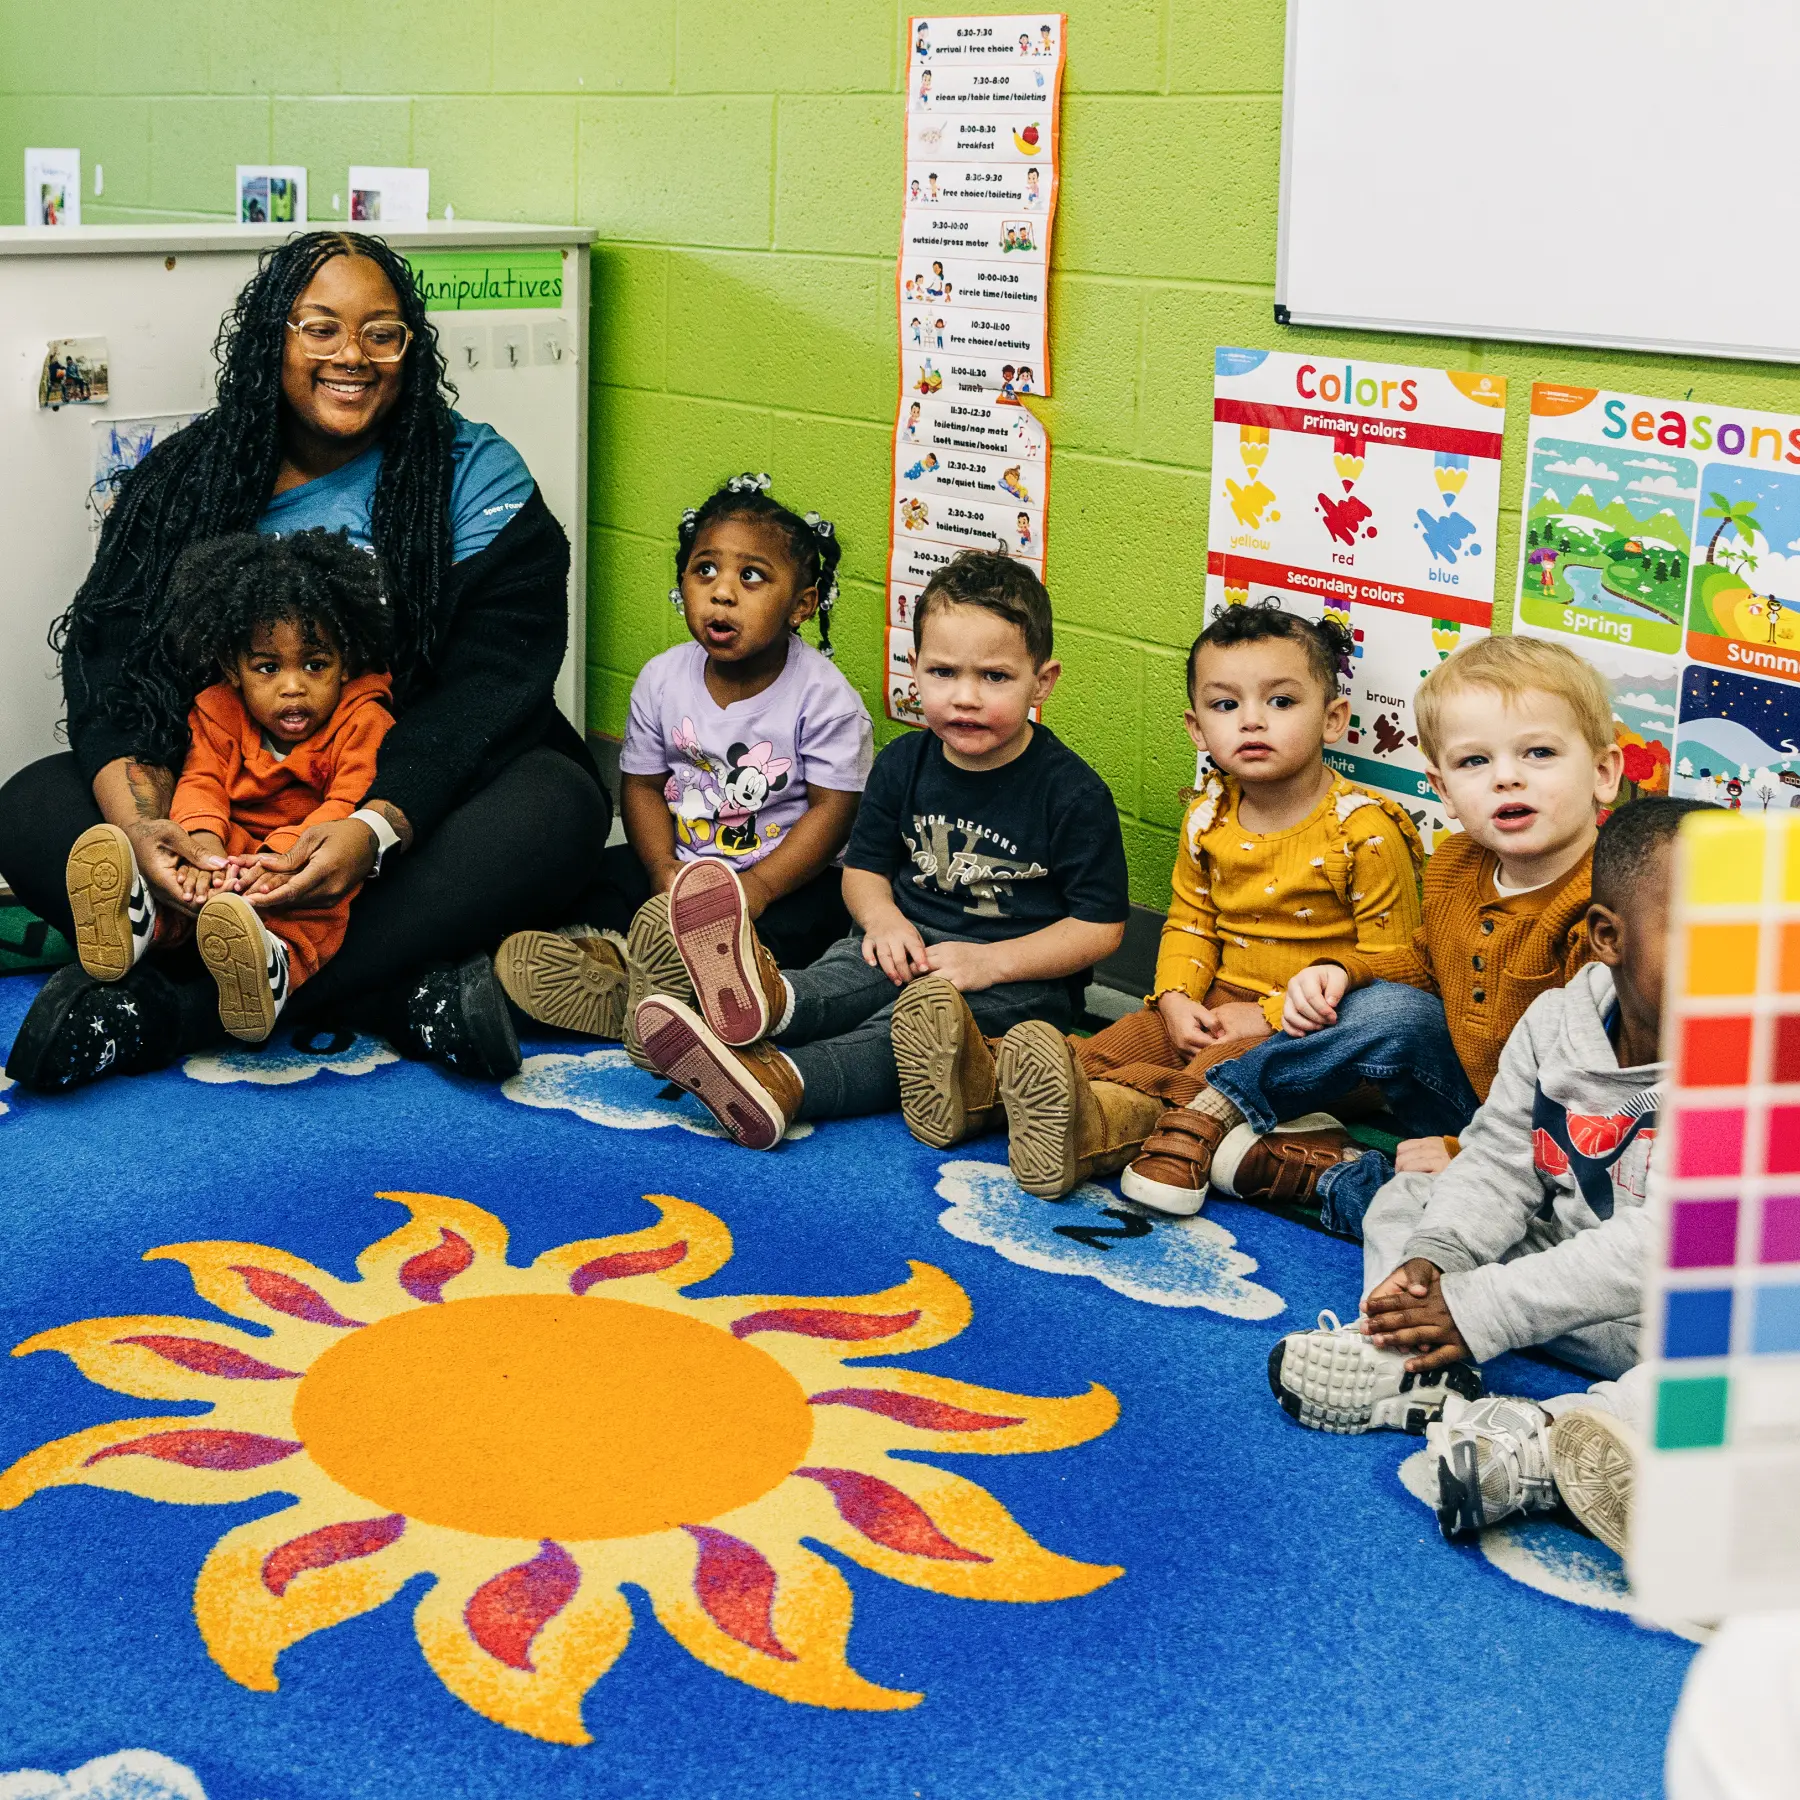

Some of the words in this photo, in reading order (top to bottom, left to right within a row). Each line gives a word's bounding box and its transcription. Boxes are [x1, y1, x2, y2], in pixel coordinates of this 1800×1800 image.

[957, 28, 993, 37] 6:30-7:30
[935, 46, 962, 54] arrival
[969, 45, 985, 53] free
[987, 44, 1014, 53] choice
[973, 76, 1010, 85] 7:30-8:00
[935, 93, 956, 101] clean
[957, 93, 990, 103] up/table
[992, 92, 1047, 102] time/toileting
[959, 125, 997, 133] 8:00-8:30
[956, 141, 995, 150] breakfast
[965, 173, 1003, 182] 8:30-9:30
[942, 188, 958, 197] free
[960, 189, 1022, 200] choice/toileting
[932, 221, 969, 230] 9:30-10:00
[912, 237, 964, 247] outside/gross
[965, 239, 989, 248] motor
[977, 272, 1019, 283] 10:00-10:30
[958, 288, 981, 297] circle
[982, 289, 1038, 302] time/toileting
[970, 320, 1011, 331] 10:30-11:00
[950, 334, 966, 344] free
[967, 336, 1031, 351] choice/activity
[951, 366, 987, 378] 11:00-11:30
[958, 382, 984, 393] lunch
[1296, 364, 1418, 412] Colors
[950, 406, 991, 418] 11:30-12:30
[933, 419, 986, 434] toileting/nap
[987, 426, 1009, 437] mats
[1303, 414, 1359, 437] primary
[1362, 422, 1407, 440] colors
[947, 460, 987, 473] 12:30-2:30
[936, 476, 976, 490] nap/quiet
[977, 480, 996, 491] time
[947, 507, 985, 521] 2:30-3:00
[935, 521, 998, 540] toileting/snack
[1230, 534, 1271, 551] yellow
[913, 550, 950, 564] 3:00-3:30
[1332, 551, 1355, 566] red
[908, 565, 925, 577] free
[1428, 567, 1460, 585] blue
[1287, 570, 1358, 599] secondary
[1361, 585, 1405, 605] colors
[1563, 609, 1633, 643] Spring
[1727, 642, 1800, 675] Summ
[1366, 689, 1406, 709] brown
[956, 818, 1018, 856] DEACONS
[1052, 1208, 1154, 1251] 2
